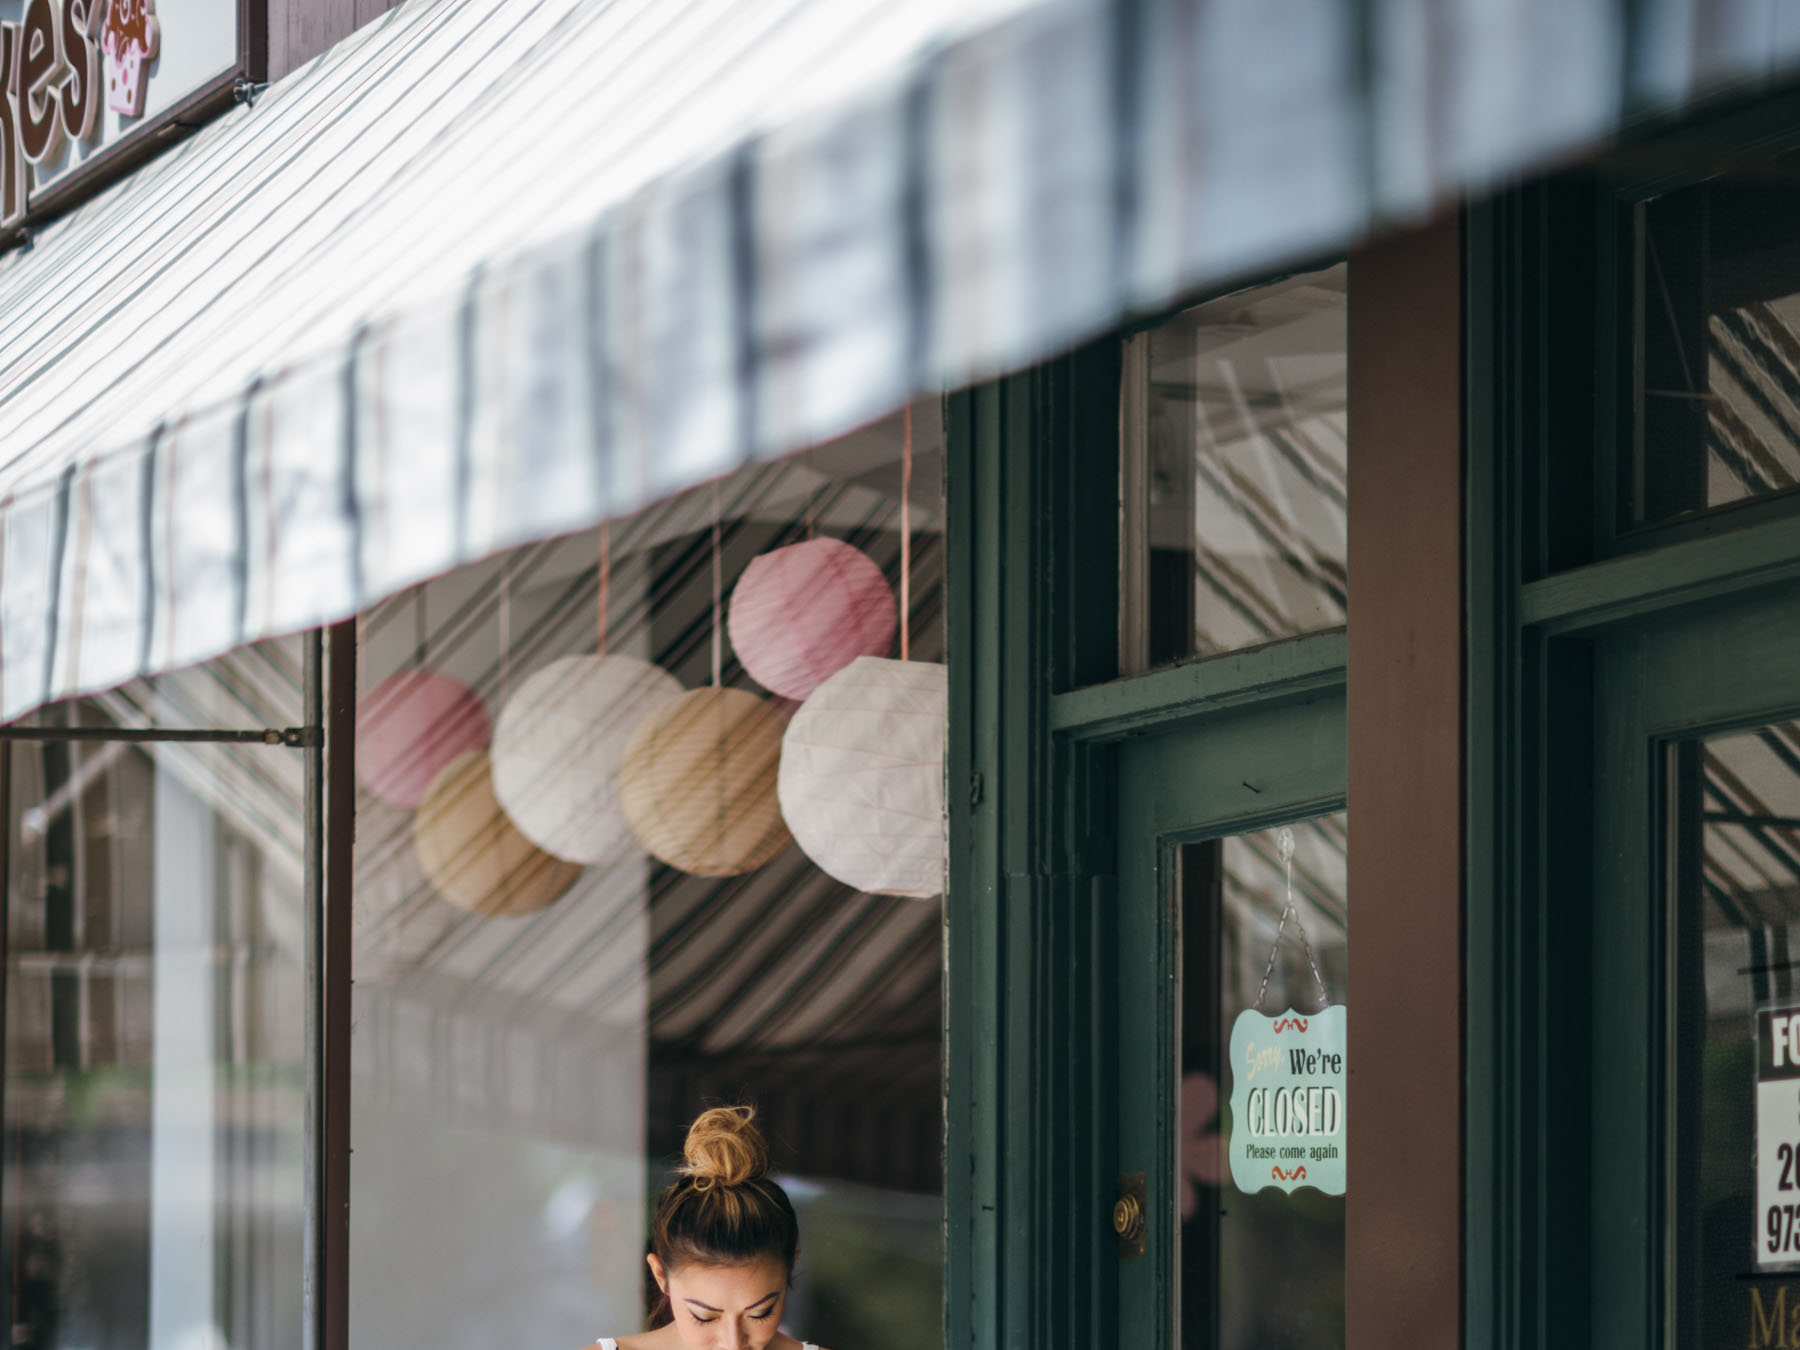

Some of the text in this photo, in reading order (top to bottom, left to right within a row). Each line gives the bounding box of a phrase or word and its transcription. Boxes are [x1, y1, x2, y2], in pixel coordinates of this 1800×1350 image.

[1289, 1048, 1342, 1075] We're
[1247, 1086, 1342, 1137] CLOSED
[1246, 1144, 1339, 1161] Please come again
